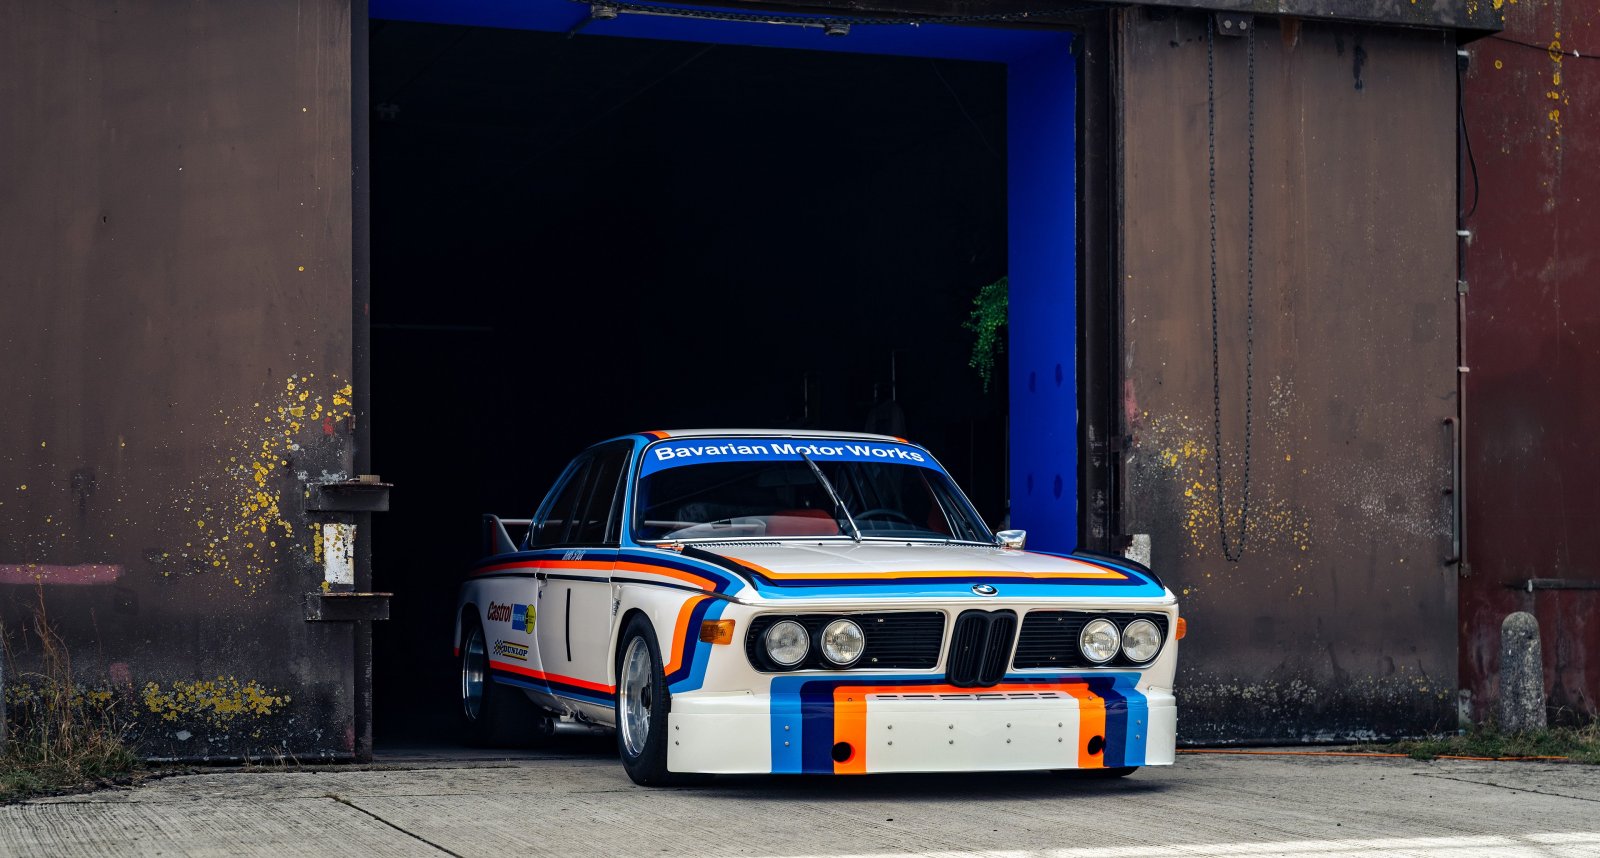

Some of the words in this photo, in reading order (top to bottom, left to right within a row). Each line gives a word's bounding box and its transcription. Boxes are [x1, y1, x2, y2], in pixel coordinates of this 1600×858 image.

[655, 443, 769, 461] Bavarian
[770, 443, 844, 456] Motor
[845, 445, 925, 462] Works
[487, 601, 513, 622] Castrol
[502, 645, 528, 656] DUNLOP
